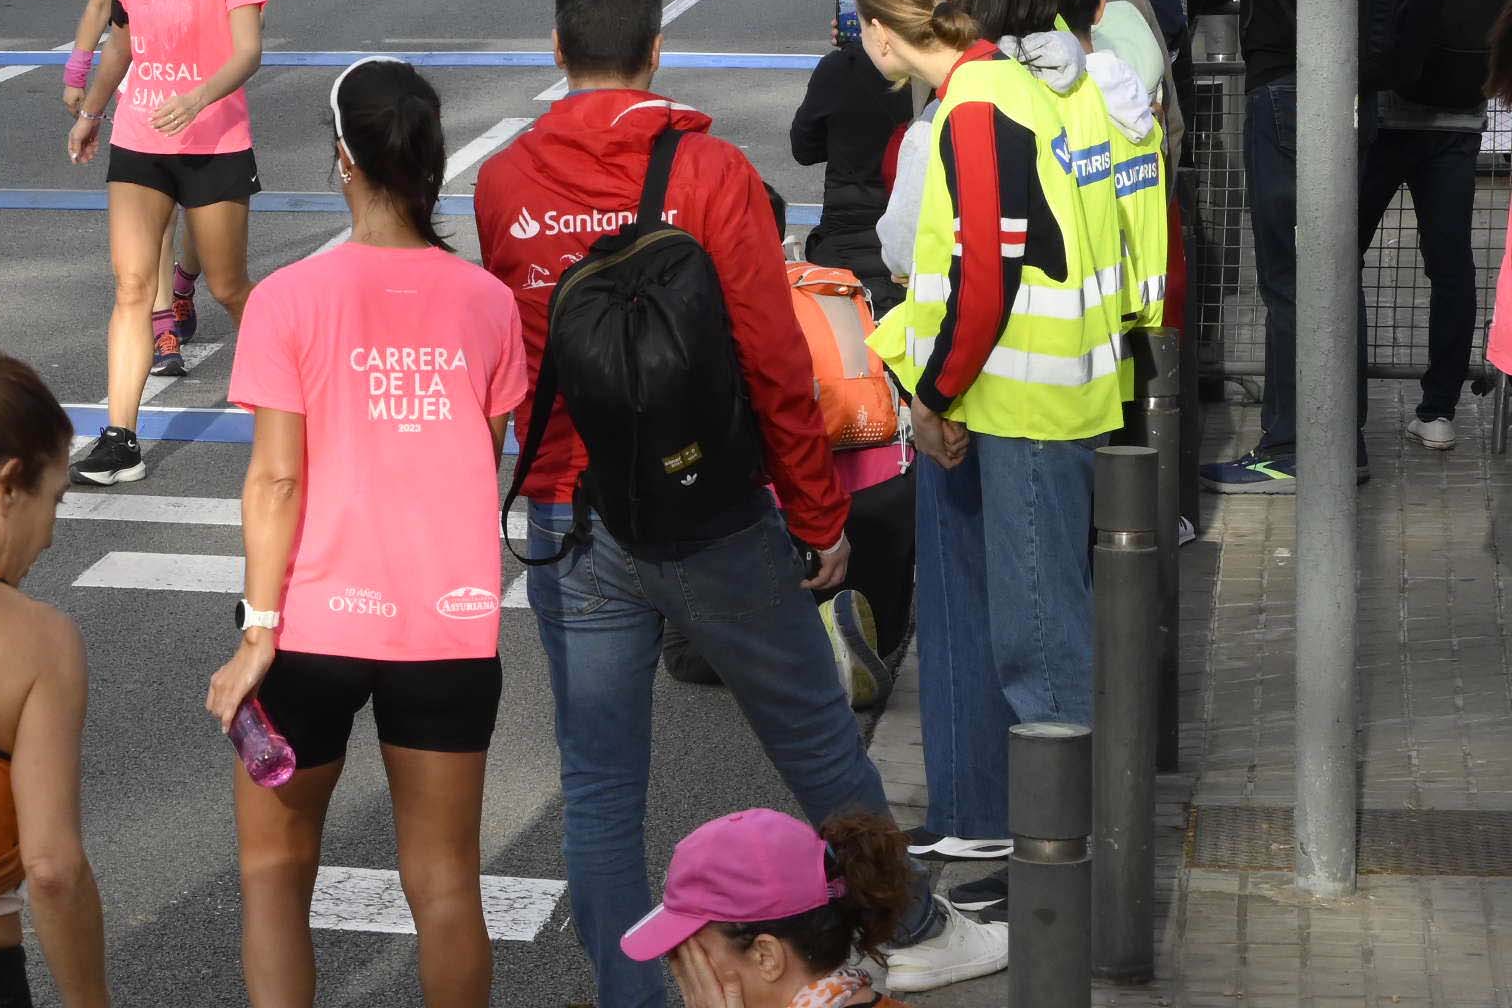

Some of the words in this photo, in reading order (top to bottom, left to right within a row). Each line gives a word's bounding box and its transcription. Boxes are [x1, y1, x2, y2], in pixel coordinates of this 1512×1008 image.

[137, 62, 203, 82] ORSAL
[349, 346, 469, 372] CARRERA
[368, 372, 404, 396] DE
[413, 372, 446, 396] LA
[367, 397, 453, 421] MUJER
[397, 423, 422, 434] 2023
[329, 595, 398, 619] OYSHO
[441, 598, 496, 613] ASTURIANA
